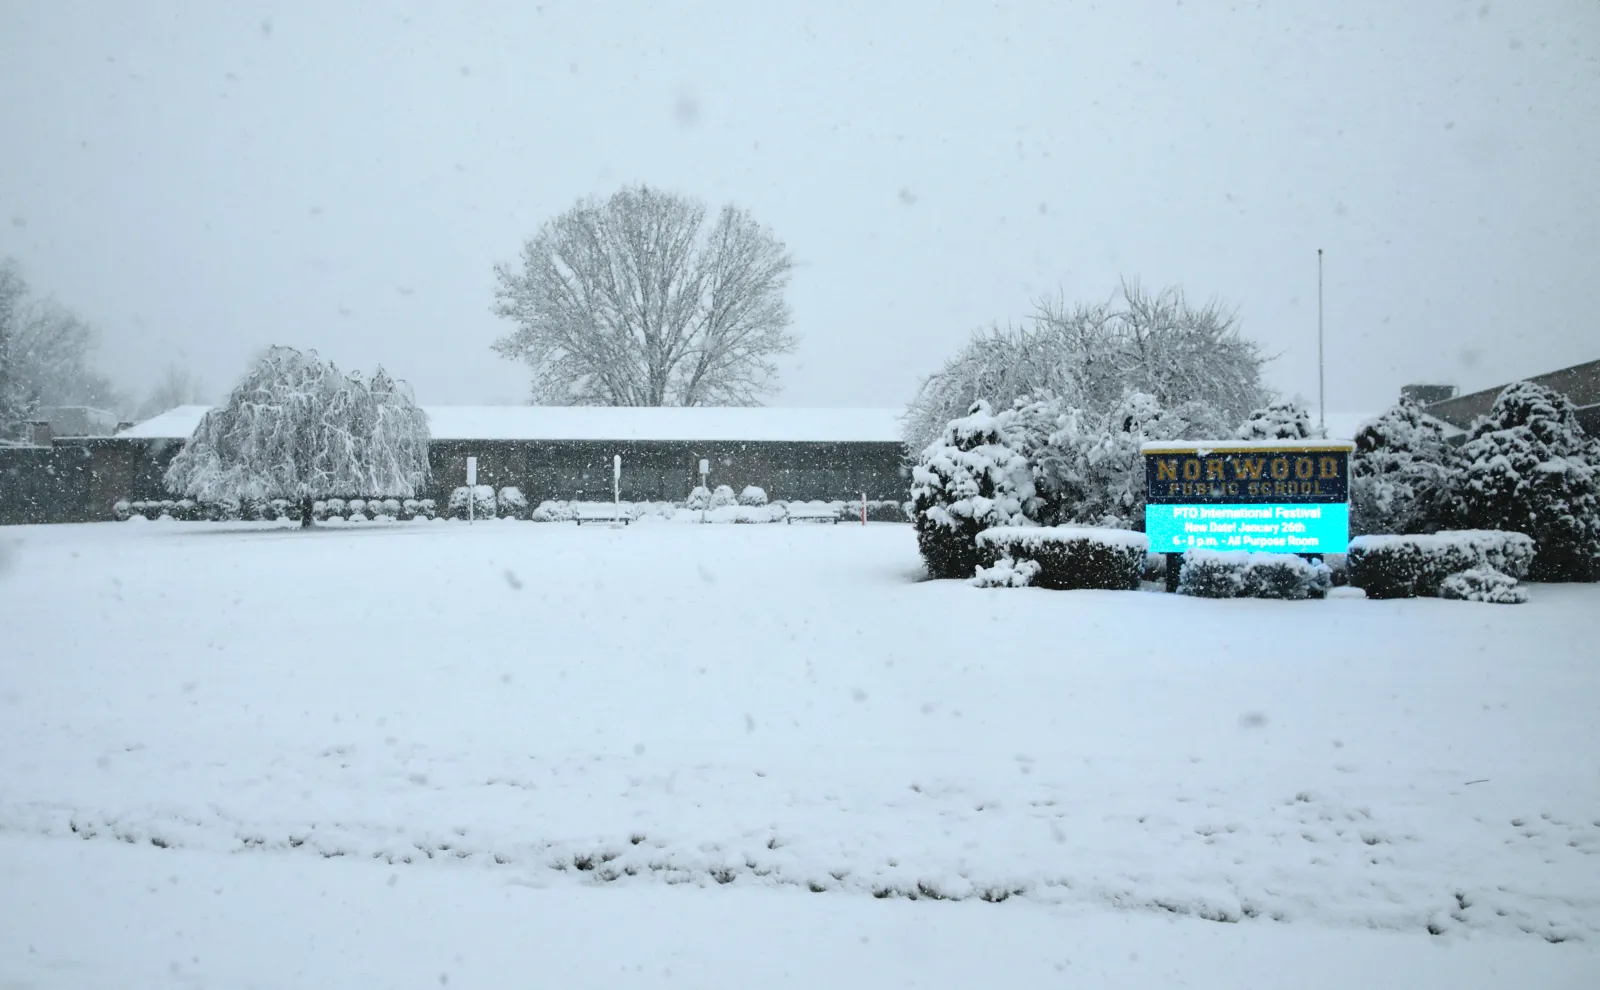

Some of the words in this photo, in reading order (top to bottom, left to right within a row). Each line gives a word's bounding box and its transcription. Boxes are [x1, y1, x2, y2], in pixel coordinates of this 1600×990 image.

[1157, 457, 1338, 481] NORWOOD
[1169, 482, 1240, 496] PUBLIC
[1249, 481, 1325, 495] SCHOOL
[1173, 507, 1198, 519] PTO
[1200, 507, 1273, 519] International
[1275, 507, 1322, 519] Festival
[1184, 522, 1208, 533] New
[1238, 522, 1279, 535] January
[1227, 535, 1241, 546] All
[1243, 536, 1286, 548] Purpose
[1287, 536, 1320, 546] Room
